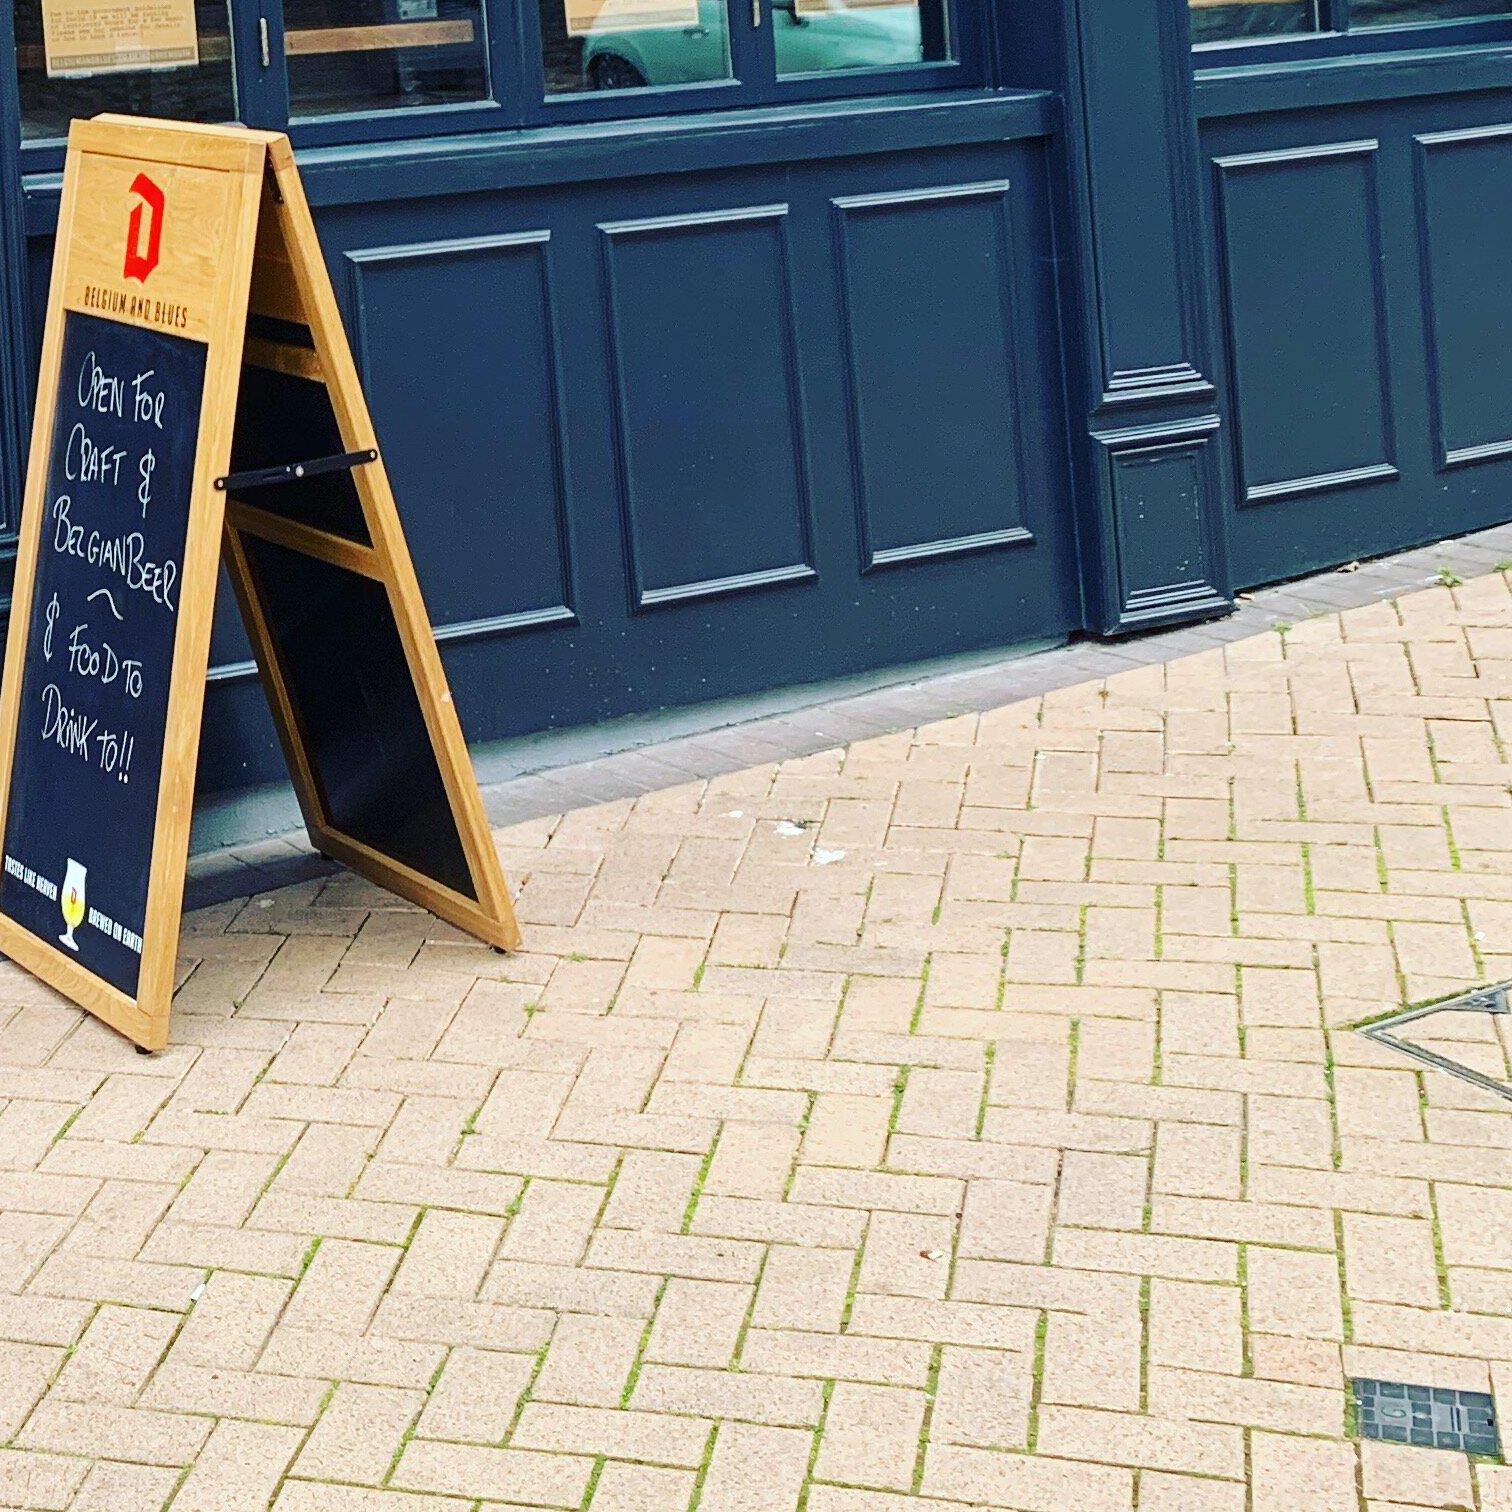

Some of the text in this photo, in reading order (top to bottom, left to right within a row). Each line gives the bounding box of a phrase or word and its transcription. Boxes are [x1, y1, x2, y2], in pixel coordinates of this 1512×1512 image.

[85, 286, 188, 328] BELGIUM AND BLUES
[78, 351, 165, 429] OPEN FOR
[65, 422, 128, 486] CRAFT
[53, 495, 176, 612] BELGIAN BEER
[68, 623, 119, 684] FOOD
[122, 659, 143, 698] TO
[4, 854, 58, 902] TASTES LIKE HEAVEN
[88, 906, 143, 954] BREWED ON EARTH
